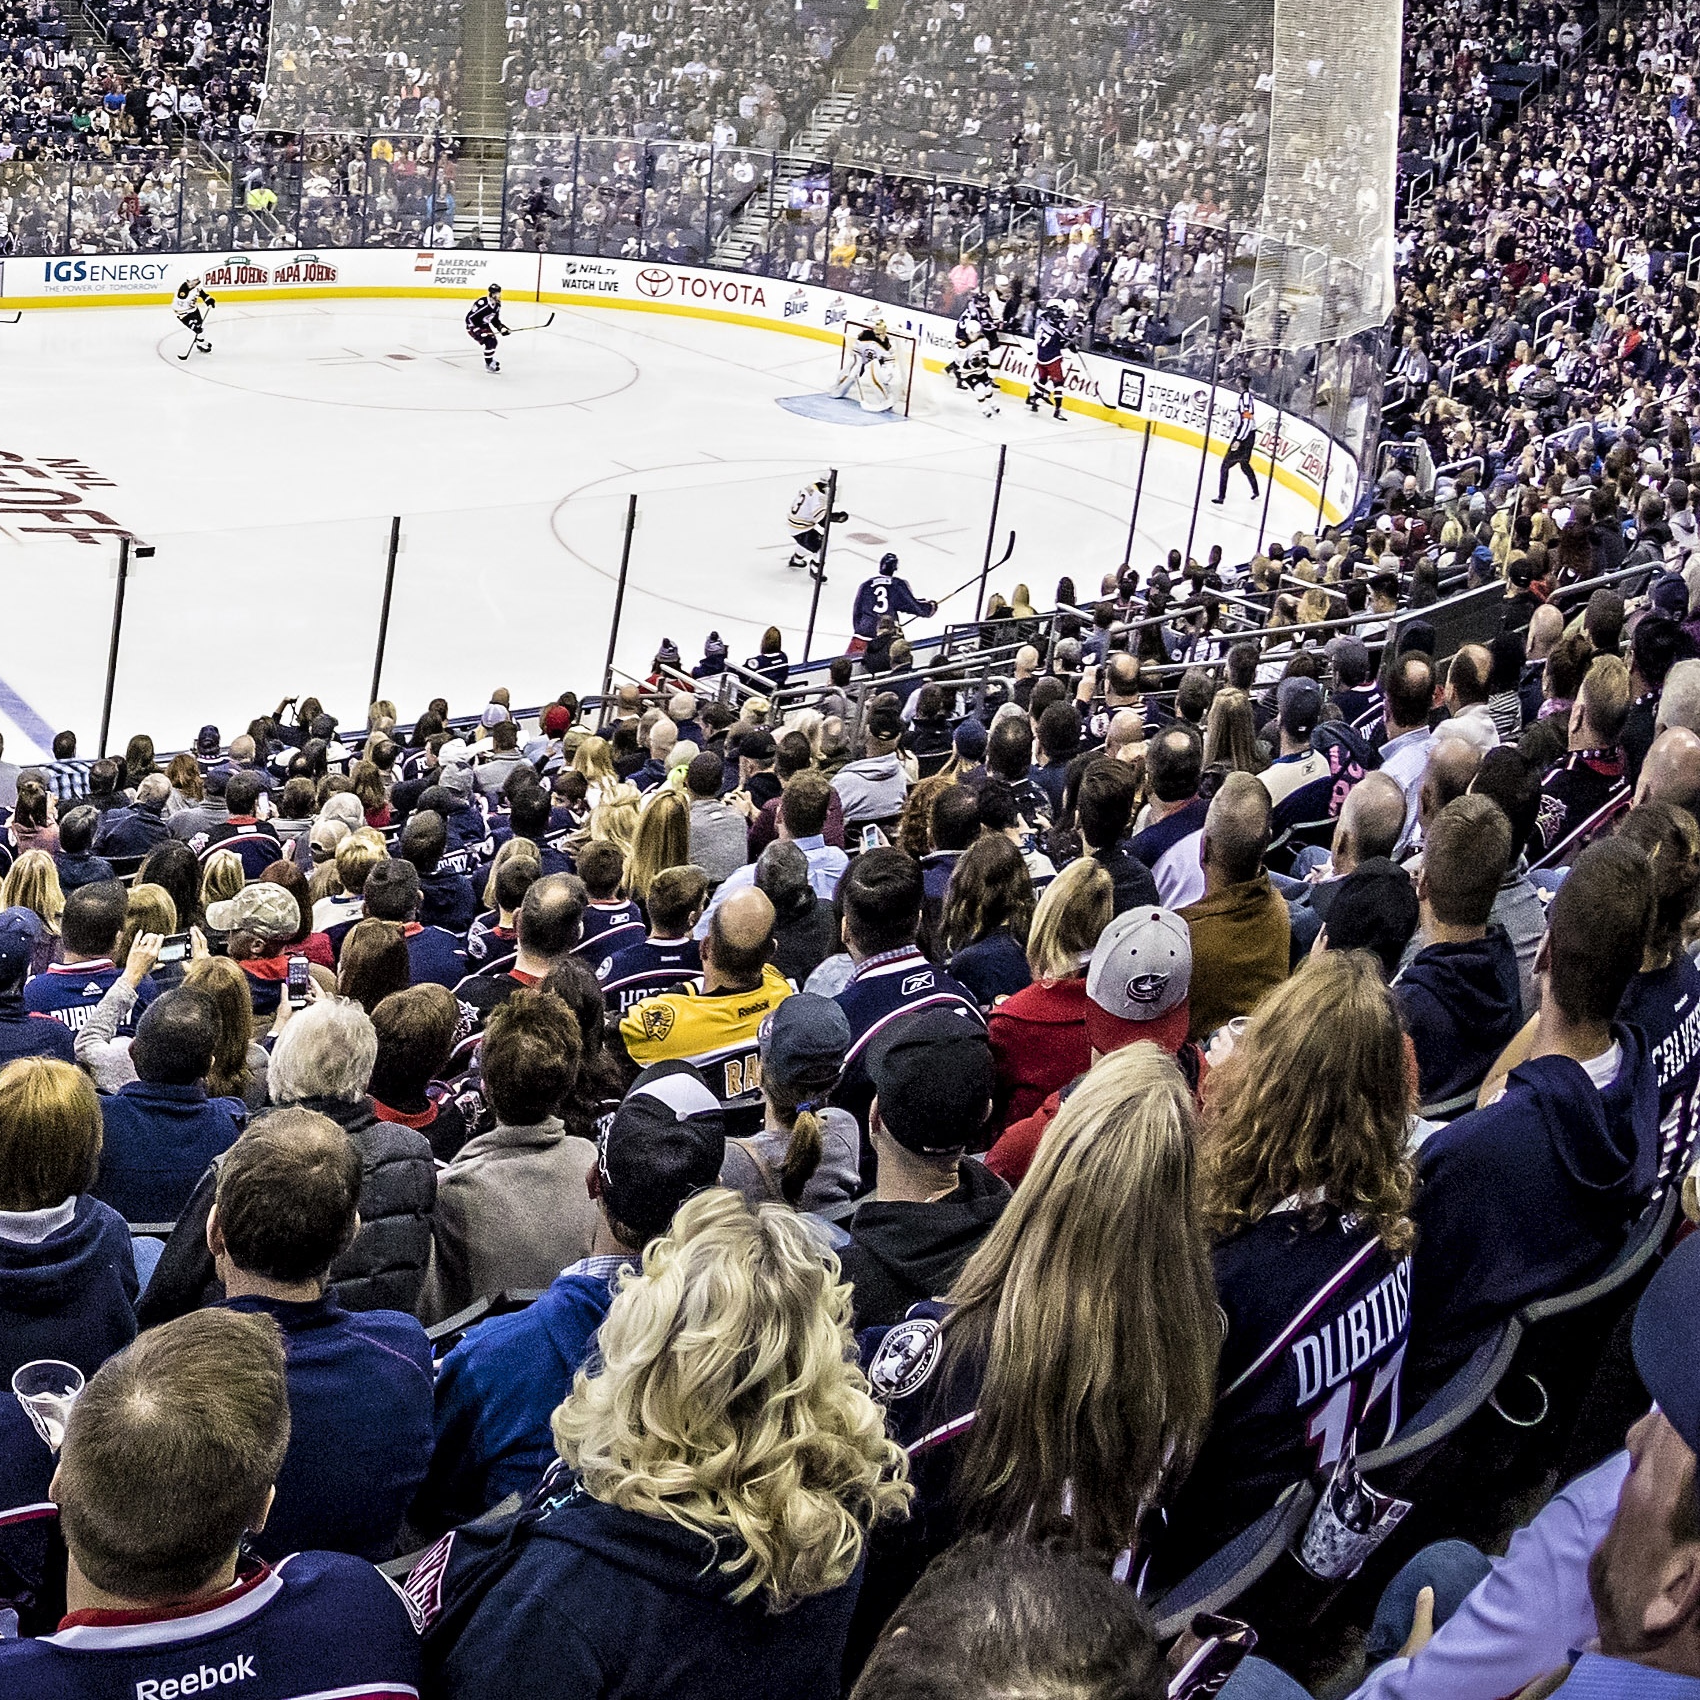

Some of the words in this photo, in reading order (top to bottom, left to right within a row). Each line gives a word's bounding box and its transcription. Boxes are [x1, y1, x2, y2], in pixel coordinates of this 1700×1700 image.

[43, 261, 87, 282] IGS
[90, 263, 169, 281] ENERGY
[436, 268, 476, 276] ELECTRIC
[437, 258, 487, 267] AMERICAN
[204, 269, 232, 286] PAPA
[273, 266, 301, 282] PAPA
[434, 276, 468, 285] POWER
[43, 284, 61, 293] THE
[63, 284, 94, 293] POWER
[95, 284, 107, 292] OF
[109, 283, 159, 292] TOMORROW
[562, 278, 595, 291] WATCH
[599, 280, 619, 292] LIVE
[678, 276, 766, 308] TOYOTA
[784, 300, 809, 318] Blue
[824, 308, 848, 326] Blue
[1000, 343, 1028, 375] Tim
[1148, 386, 1191, 406] STREAM
[1159, 404, 1180, 422] FOX
[36, 457, 119, 491] NHL
[872, 586, 890, 614] 3
[738, 1000, 770, 1017] Reebok
[1292, 1256, 1411, 1407] DUBINS
[136, 1654, 257, 1700] Reebok
